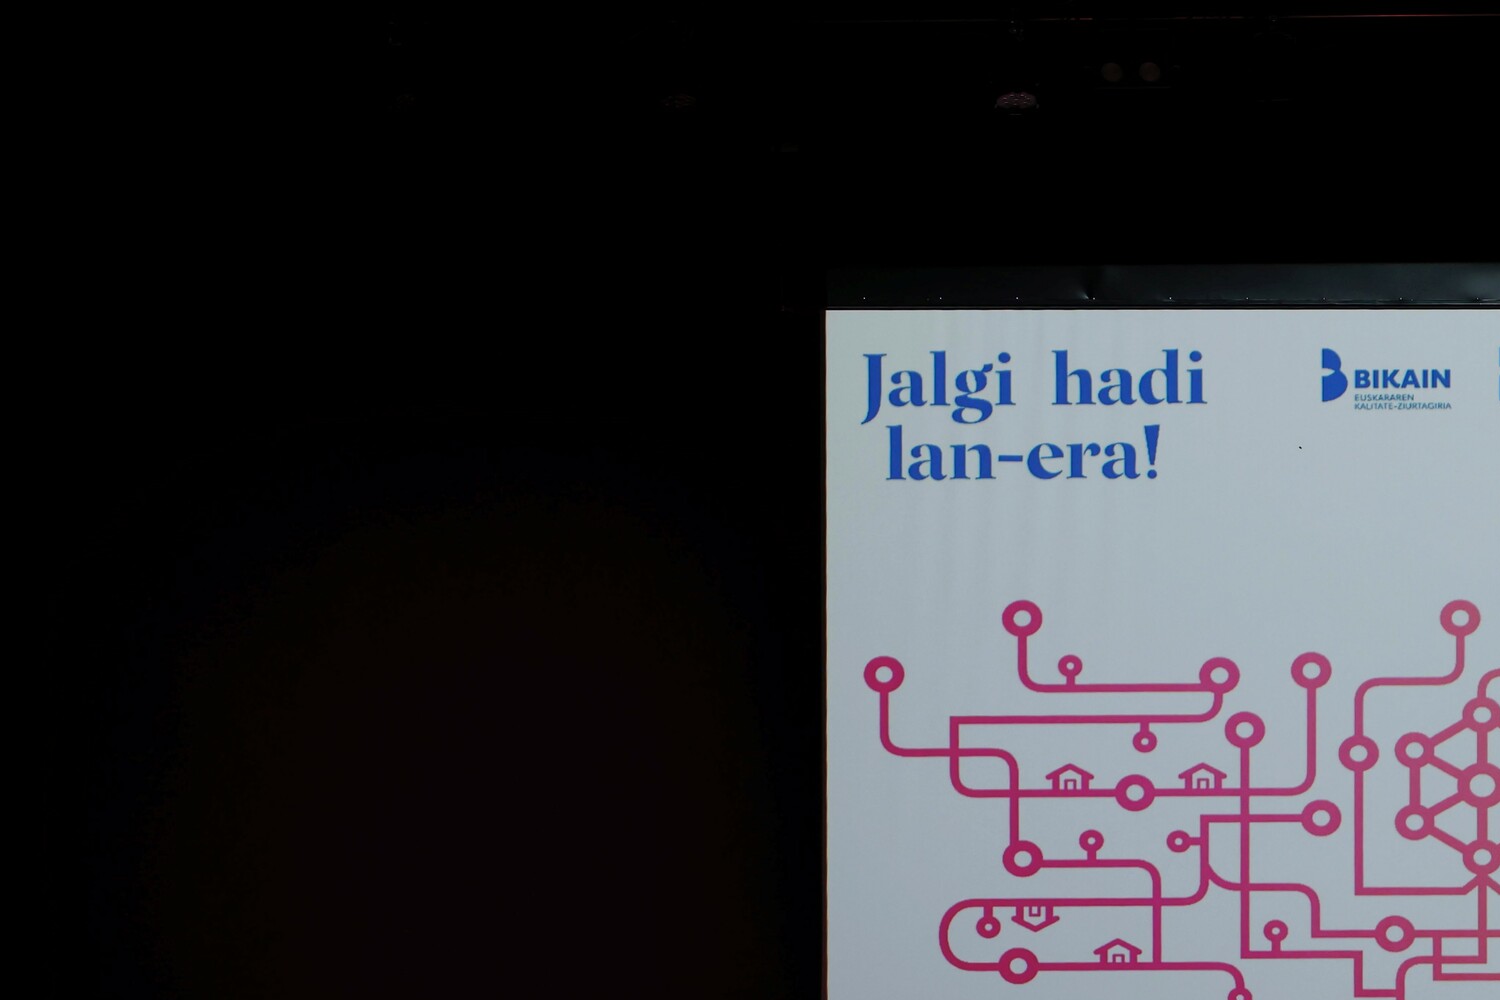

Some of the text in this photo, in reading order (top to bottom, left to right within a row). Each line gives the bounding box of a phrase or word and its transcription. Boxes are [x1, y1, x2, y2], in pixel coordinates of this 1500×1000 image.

[861, 349, 1207, 424] Jalgi hadi
[1354, 369, 1451, 389] BIKAIN
[886, 424, 1160, 481] lan-era!
